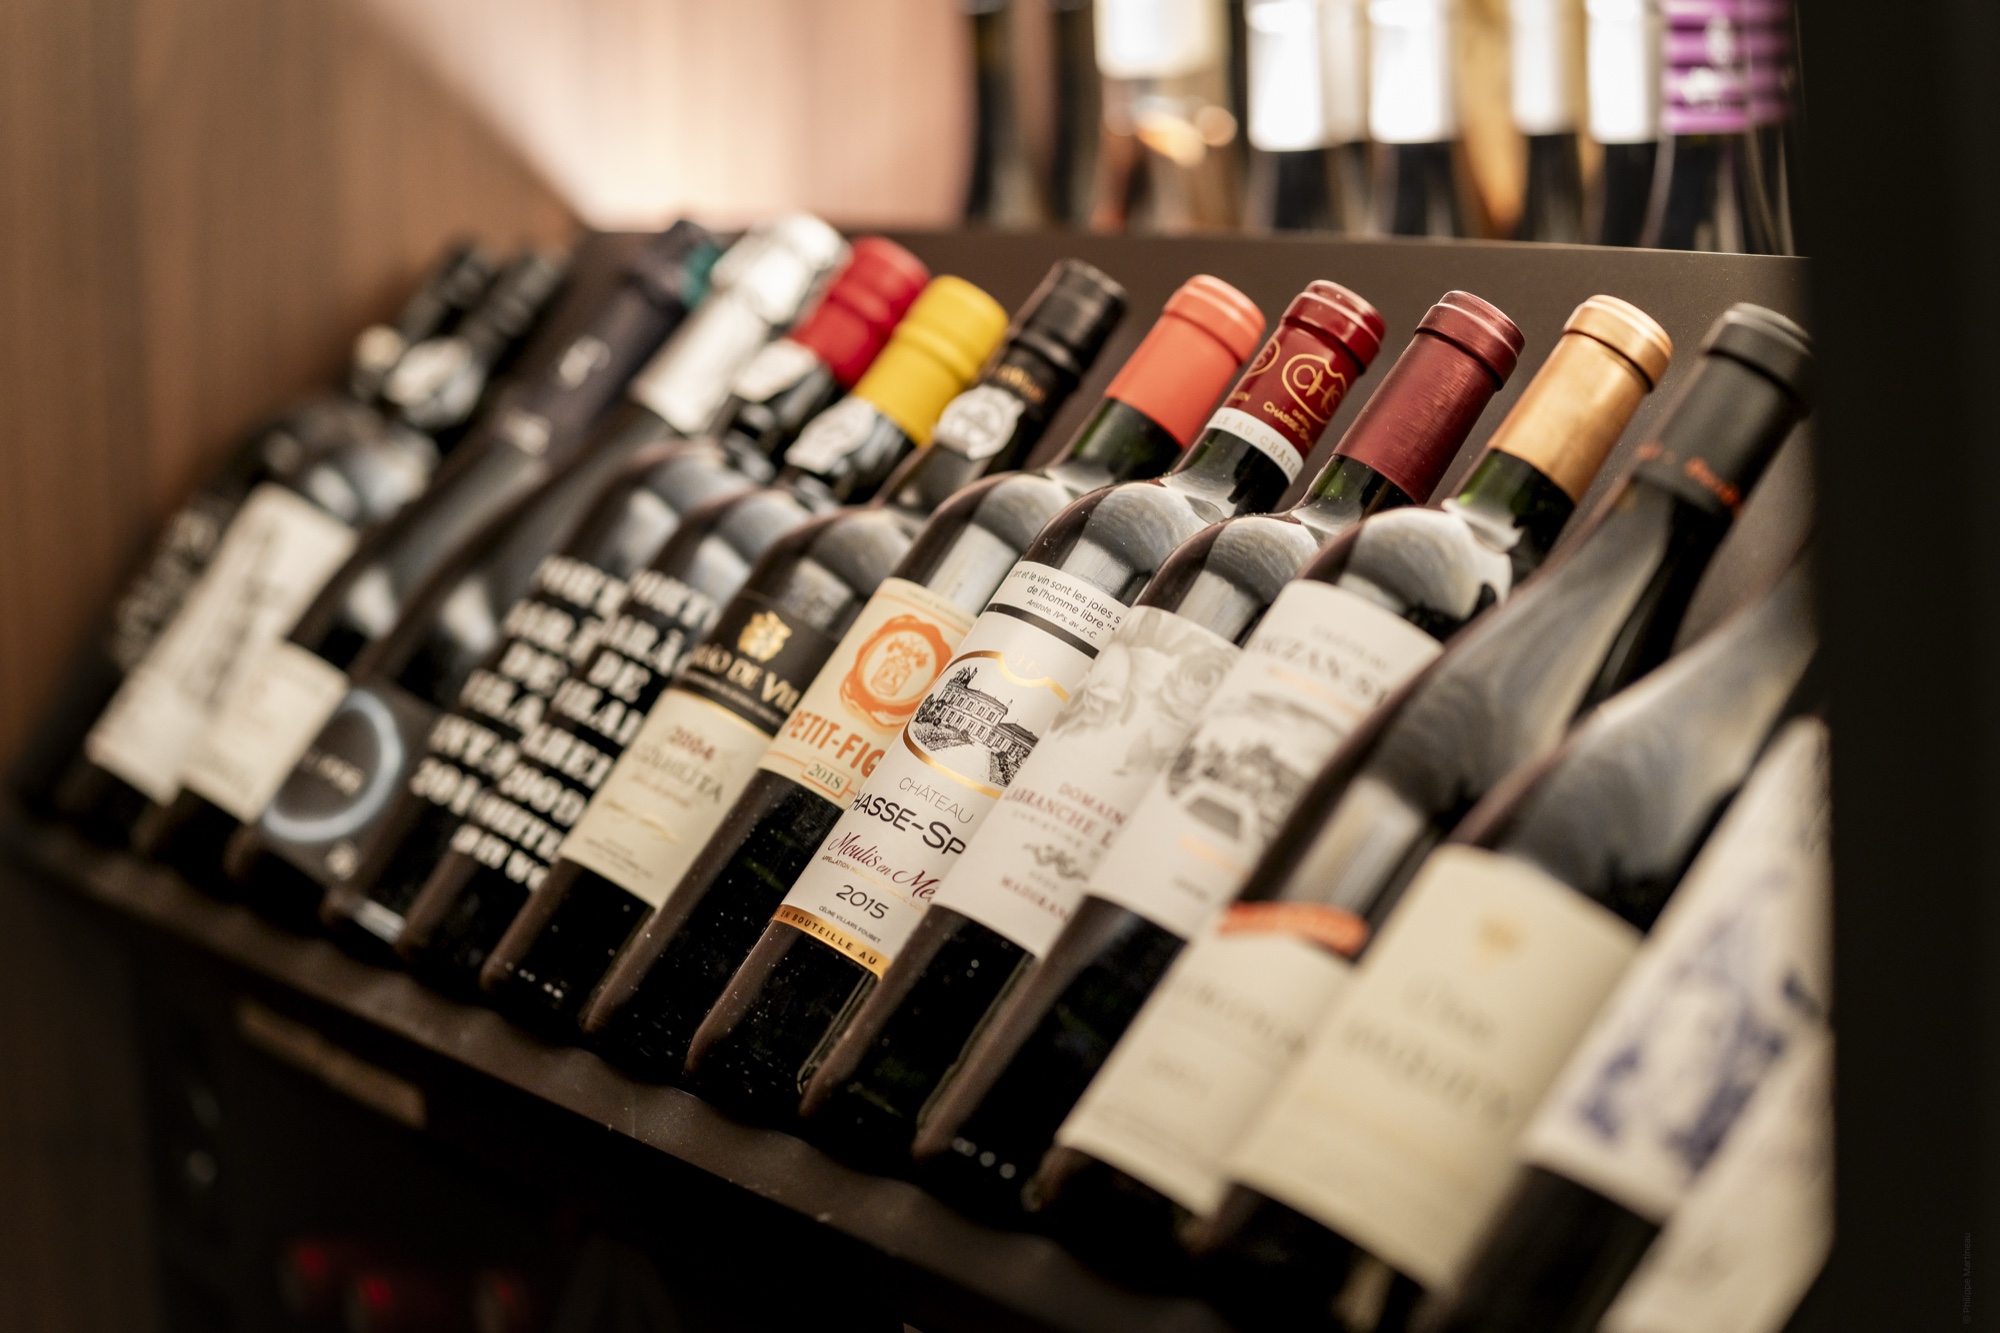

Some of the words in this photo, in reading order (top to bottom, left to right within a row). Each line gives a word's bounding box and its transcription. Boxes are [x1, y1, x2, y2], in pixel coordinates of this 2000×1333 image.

[1026, 585, 1039, 595] de
[1038, 588, 1079, 614] l'homme
[1037, 575, 1050, 586] vin
[1050, 580, 1071, 596] sont
[1072, 590, 1088, 604] les
[1087, 598, 1113, 618] joies
[726, 657, 764, 691] DE
[807, 763, 844, 790] 2018
[899, 777, 975, 824] CHÂTEAU
[1058, 782, 1126, 827] DOMAIN
[851, 790, 967, 855] HASSE-SP
[827, 832, 882, 868] Moulis
[876, 864, 892, 875] en
[835, 884, 889, 920] 2015
[791, 913, 854, 950] BOUTEILLE
[858, 951, 878, 965] AU
